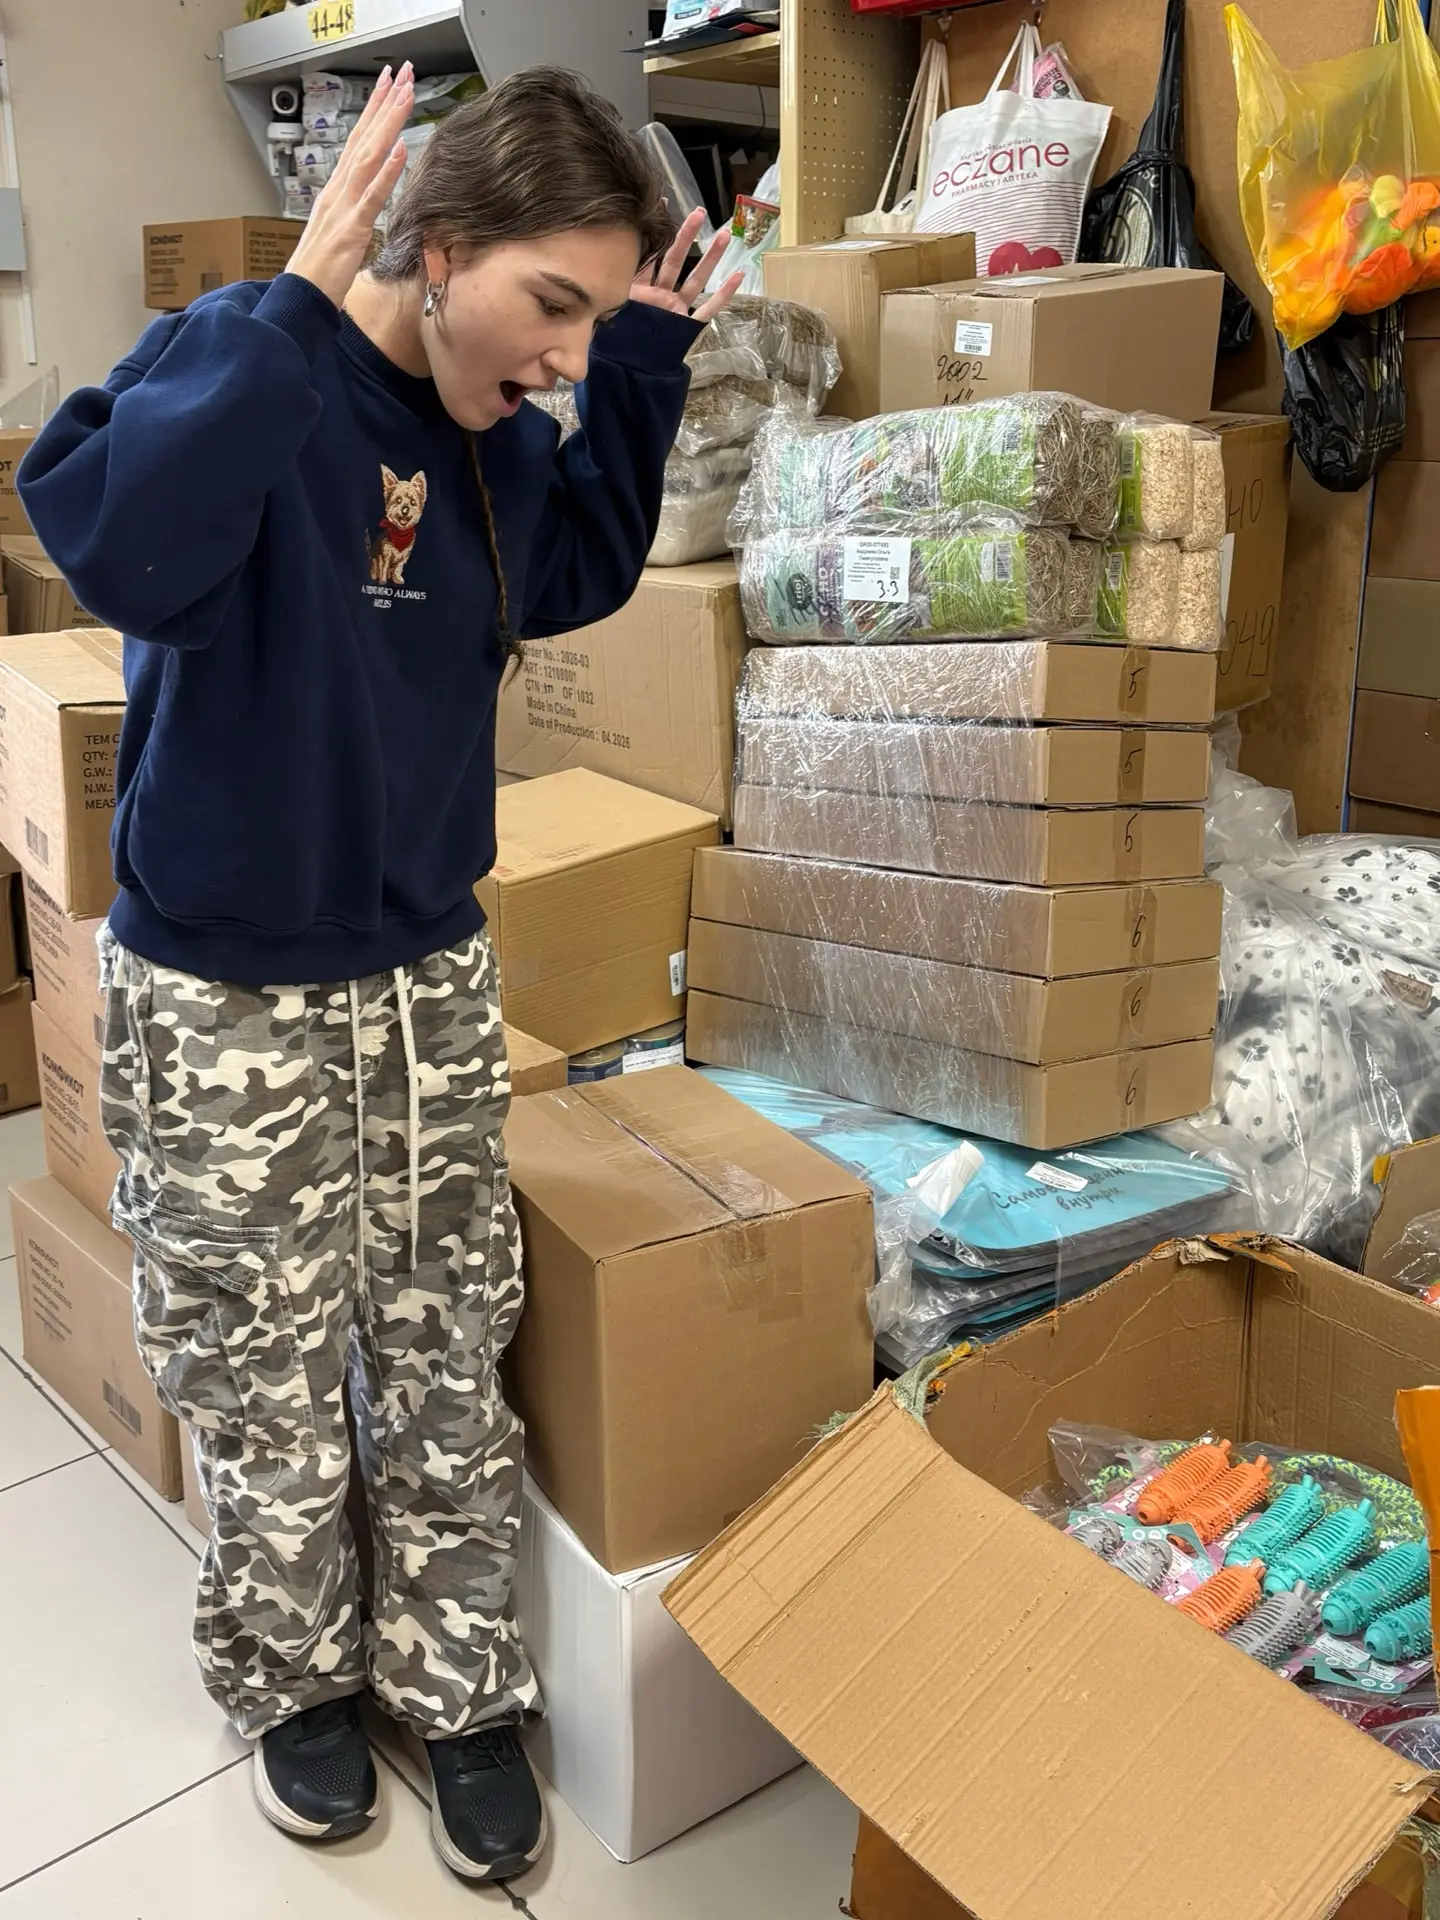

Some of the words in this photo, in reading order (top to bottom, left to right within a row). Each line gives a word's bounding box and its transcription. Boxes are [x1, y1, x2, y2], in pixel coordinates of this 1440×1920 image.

[311, 3, 355, 39] 44-48
[932, 142, 1071, 197] eczane
[1003, 171, 1039, 186] АПТЕКА
[951, 180, 996, 199] PHARMACY
[394, 589, 427, 601] ALWAYS
[876, 579, 899, 599] 3.3
[562, 686, 573, 700] OF
[1127, 666, 1142, 699] 5
[527, 696, 545, 712] Made
[546, 700, 553, 713] in
[554, 702, 577, 719] China
[528, 713, 545, 728] Date
[545, 718, 553, 730] of
[554, 719, 595, 741] Production
[601, 729, 631, 749] 04.2026
[82, 751, 109, 763] QTY:
[1123, 747, 1144, 775] 5
[83, 767, 113, 778] G.W.:
[84, 783, 114, 794] N.W.:
[1124, 813, 1139, 854] 5
[1131, 913, 1144, 949] 6
[1130, 984, 1142, 1018] 6
[1124, 1066, 1138, 1107] 6
